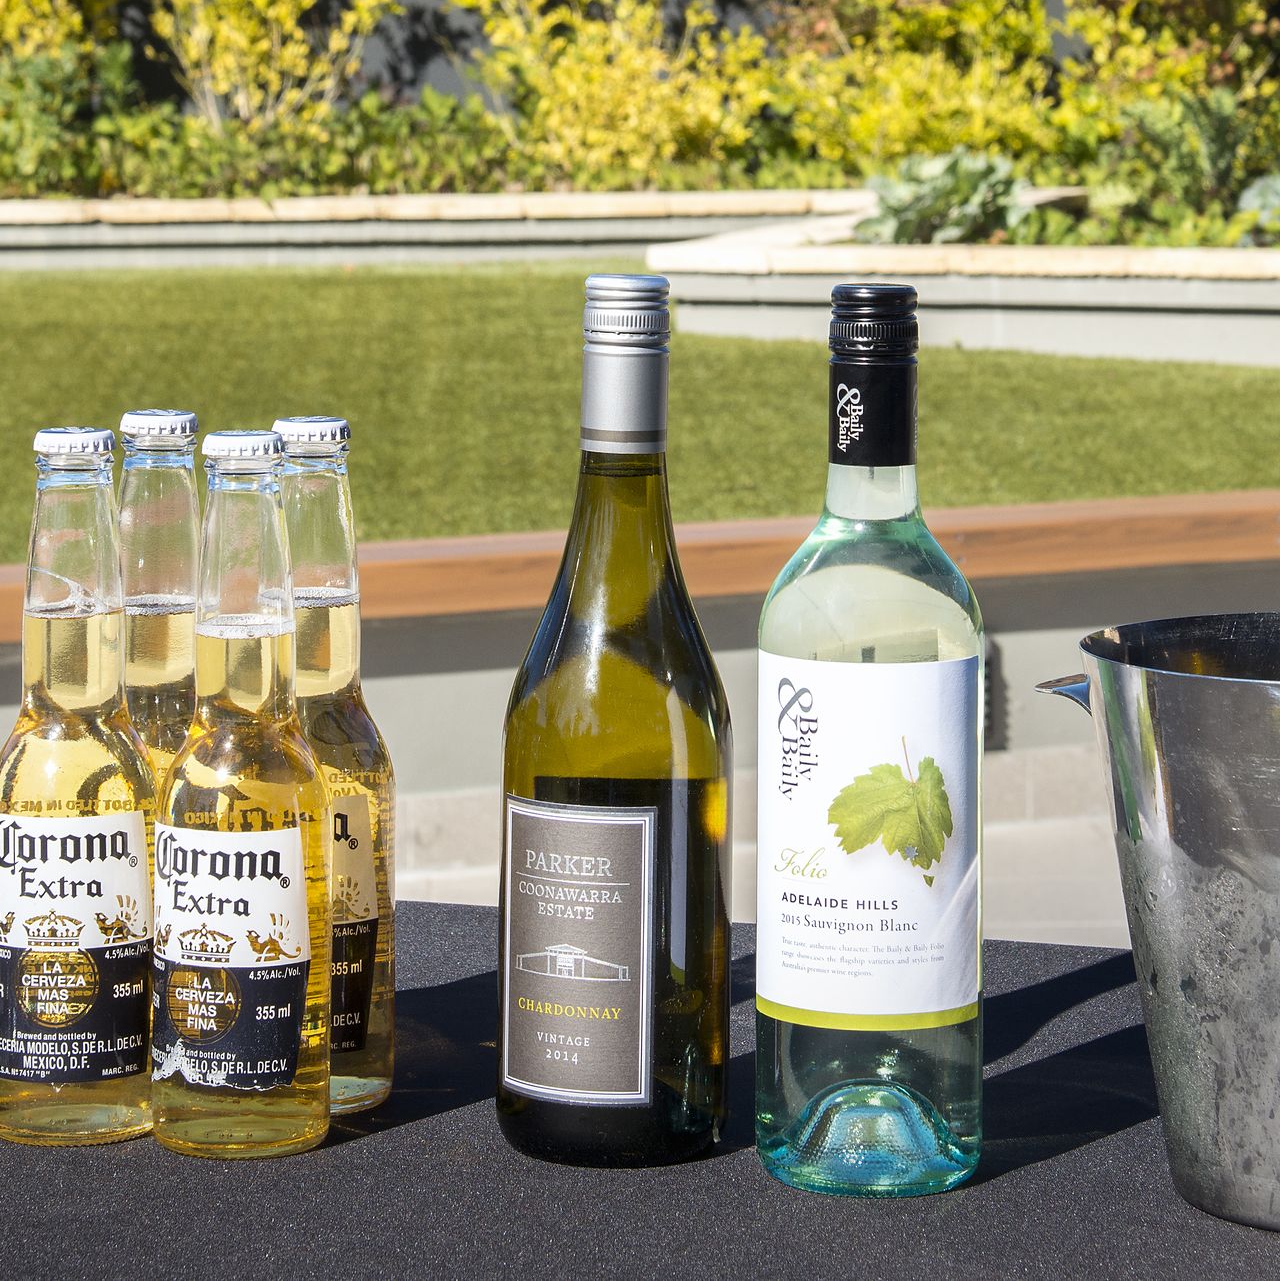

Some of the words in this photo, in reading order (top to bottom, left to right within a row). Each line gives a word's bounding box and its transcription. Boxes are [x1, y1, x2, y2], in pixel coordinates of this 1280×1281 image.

[837, 383, 860, 417] &
[848, 404, 864, 440] Baily
[837, 416, 850, 453] Baily
[778, 677, 814, 735] &
[795, 716, 819, 781] Baily
[779, 736, 799, 801] Baily
[156, 830, 283, 887] Corona
[525, 849, 613, 877] PARKER
[774, 847, 828, 879] Folio
[19, 867, 103, 899] Extra
[173, 879, 251, 917] Extra
[519, 881, 622, 903] COONAWARRA
[781, 892, 849, 909] ADELAIDE
[856, 900, 899, 910] HILLS
[538, 902, 594, 919] ESTATE
[781, 913, 801, 926] 2015
[803, 914, 874, 935] Sauvignon
[880, 919, 919, 932] Blanc
[43, 962, 63, 973] LA
[351, 959, 362, 973] ml
[22, 975, 86, 987] CERVEZA
[113, 983, 130, 998] 355
[132, 980, 144, 994] ml
[194, 977, 211, 990] LA
[38, 989, 69, 1001] MAS
[175, 988, 235, 1004] CERVEZA
[37, 1002, 69, 1014] FINA
[188, 1004, 217, 1017] MAS
[256, 1006, 275, 1020] 355
[278, 1003, 291, 1019] ml
[518, 997, 621, 1019] CHARDONNAY
[187, 1017, 217, 1031] FINA
[17, 1031, 42, 1040] Brewed
[43, 1032, 56, 1040] and
[58, 1032, 86, 1040] bottled
[87, 1031, 96, 1041] by
[537, 1031, 590, 1047] VINTAGE
[23, 1055, 67, 1071] MEXICO,
[70, 1056, 90, 1069] D.F.
[186, 1049, 198, 1057] and
[199, 1050, 225, 1060] bottled
[226, 1052, 236, 1061] by
[546, 1049, 578, 1065] 2014
[20, 1069, 34, 1077] 7417
